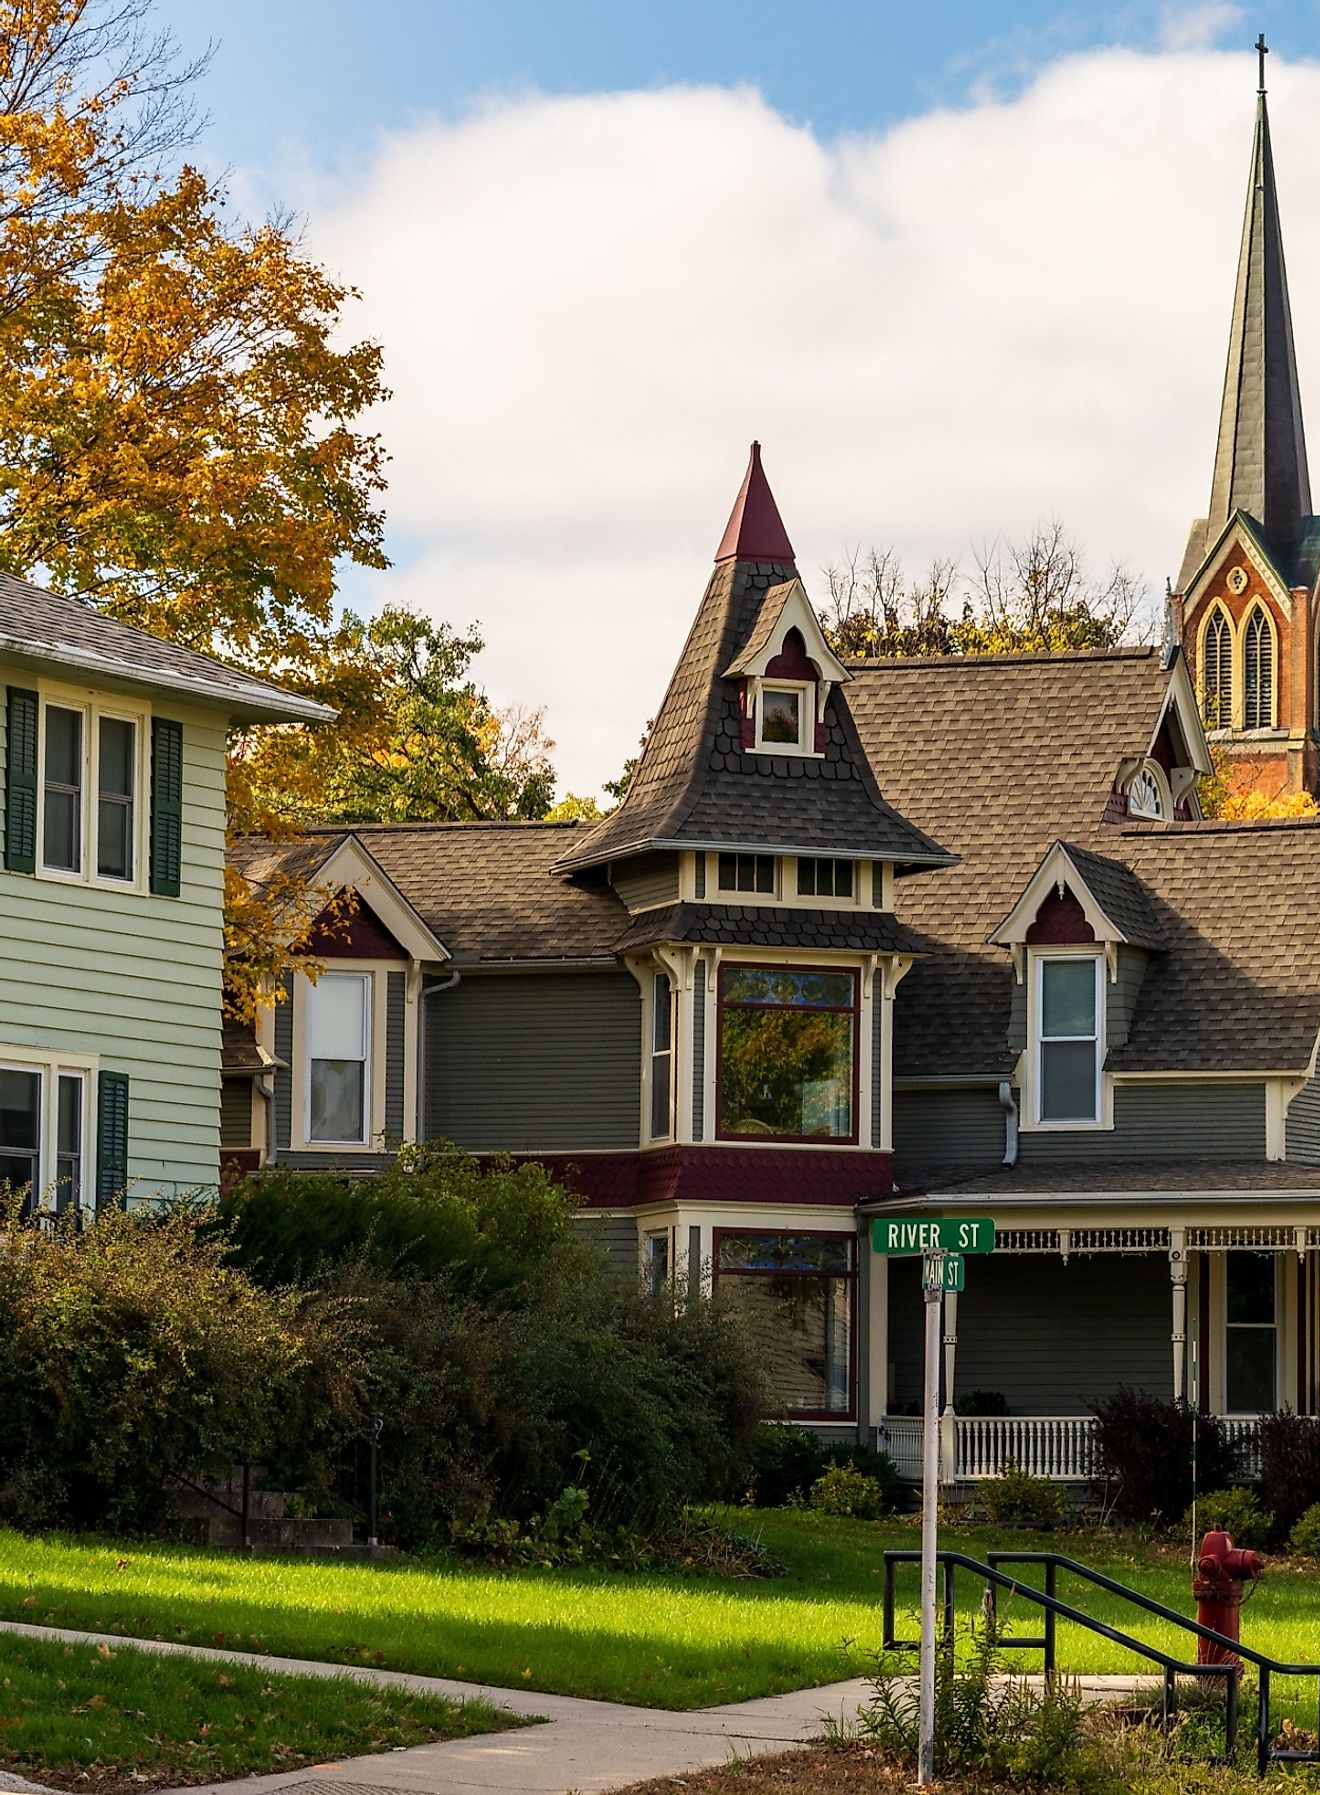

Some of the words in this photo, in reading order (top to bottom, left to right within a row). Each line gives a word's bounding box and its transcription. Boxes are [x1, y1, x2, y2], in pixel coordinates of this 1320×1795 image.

[888, 1223, 940, 1248] RIVER
[958, 1223, 980, 1248] ST
[947, 1261, 959, 1286] ST
